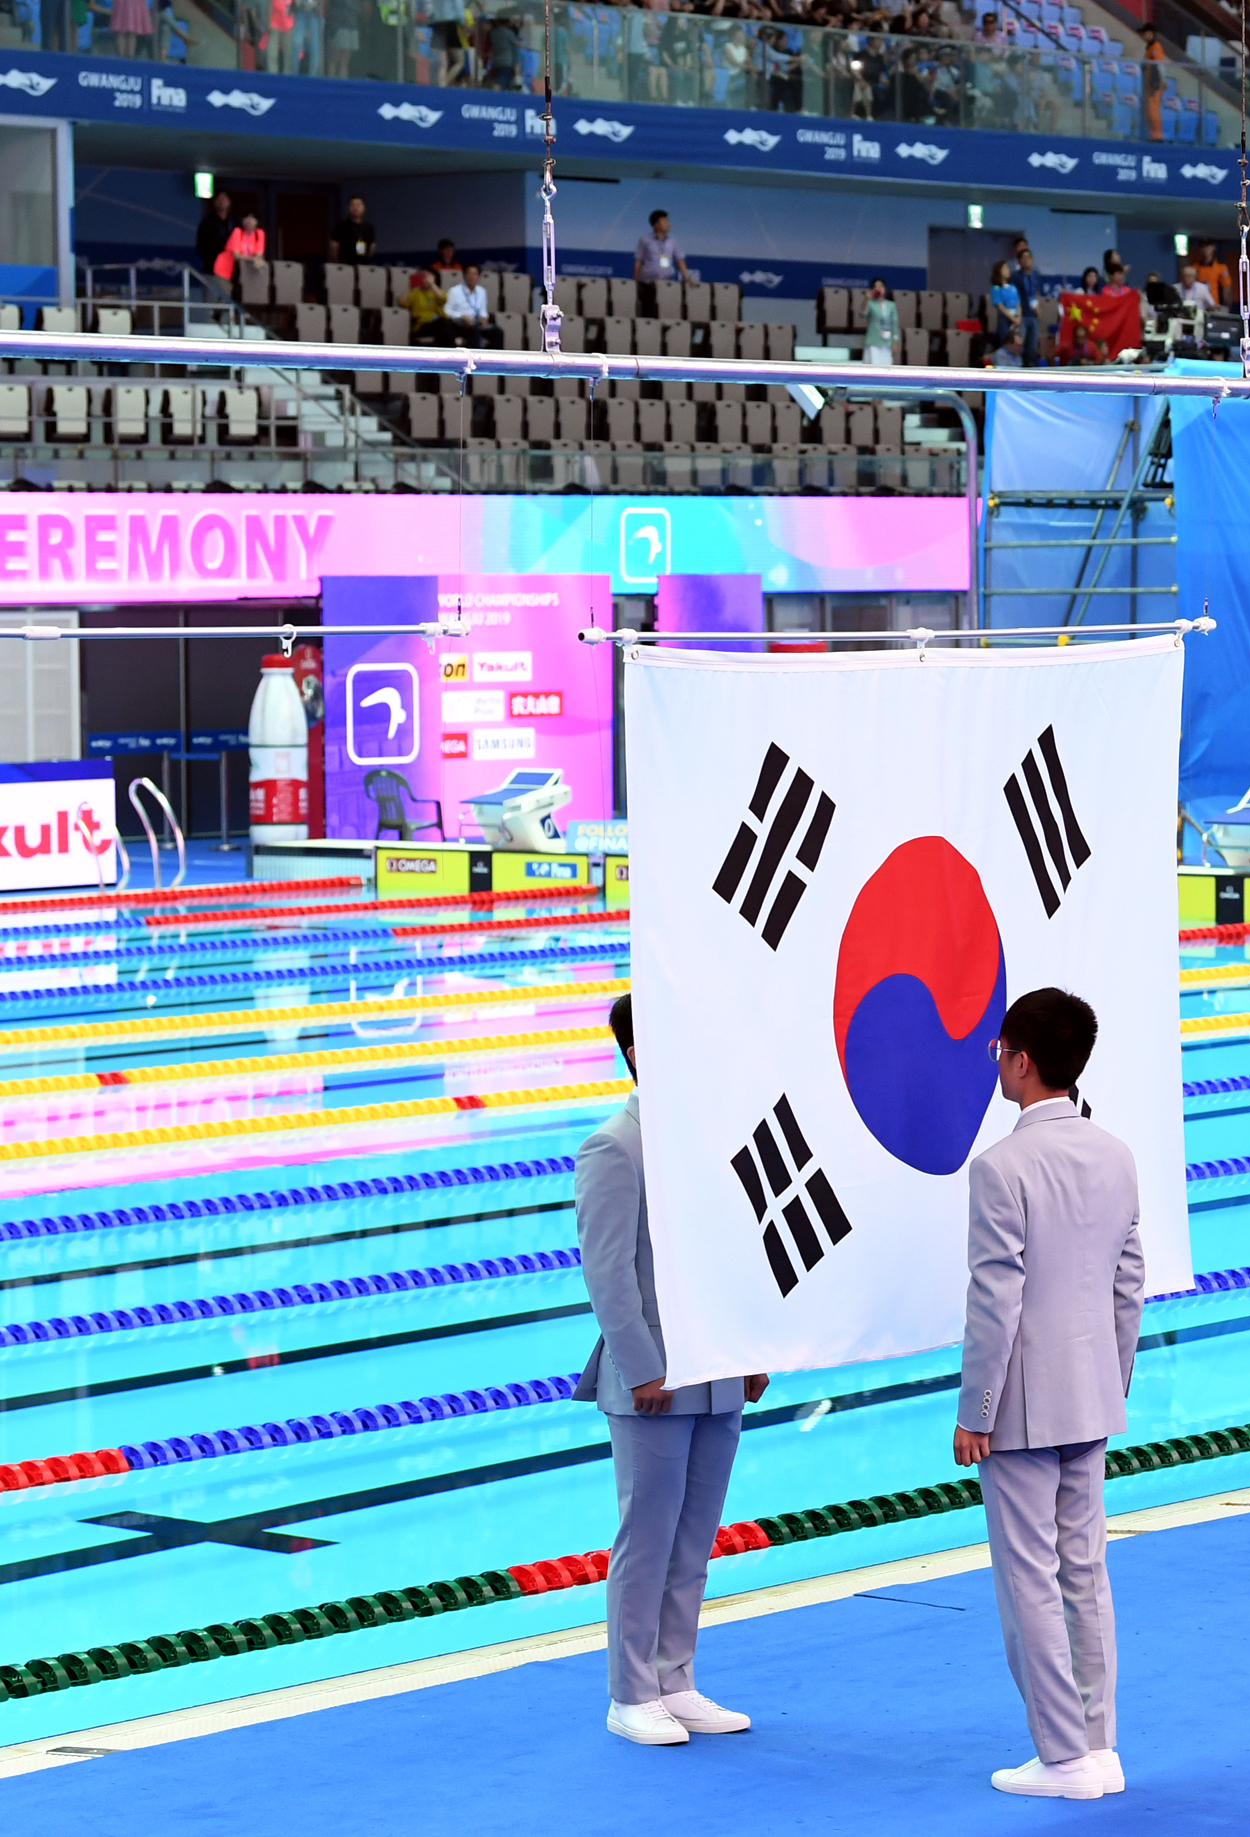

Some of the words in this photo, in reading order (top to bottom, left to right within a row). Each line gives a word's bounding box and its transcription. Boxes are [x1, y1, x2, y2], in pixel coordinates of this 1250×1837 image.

[78, 71, 142, 92] GWANGJU
[113, 92, 142, 109] 2019
[461, 103, 517, 122] GWANGJU
[492, 122, 518, 138] 2019
[796, 128, 847, 147] GWANGJU
[823, 146, 847, 160] 2019
[1092, 151, 1137, 168] GWANGJU
[478, 661, 527, 672] Yakult
[476, 738, 531, 750] SAMSUNG
[398, 859, 437, 873] OMEGA
